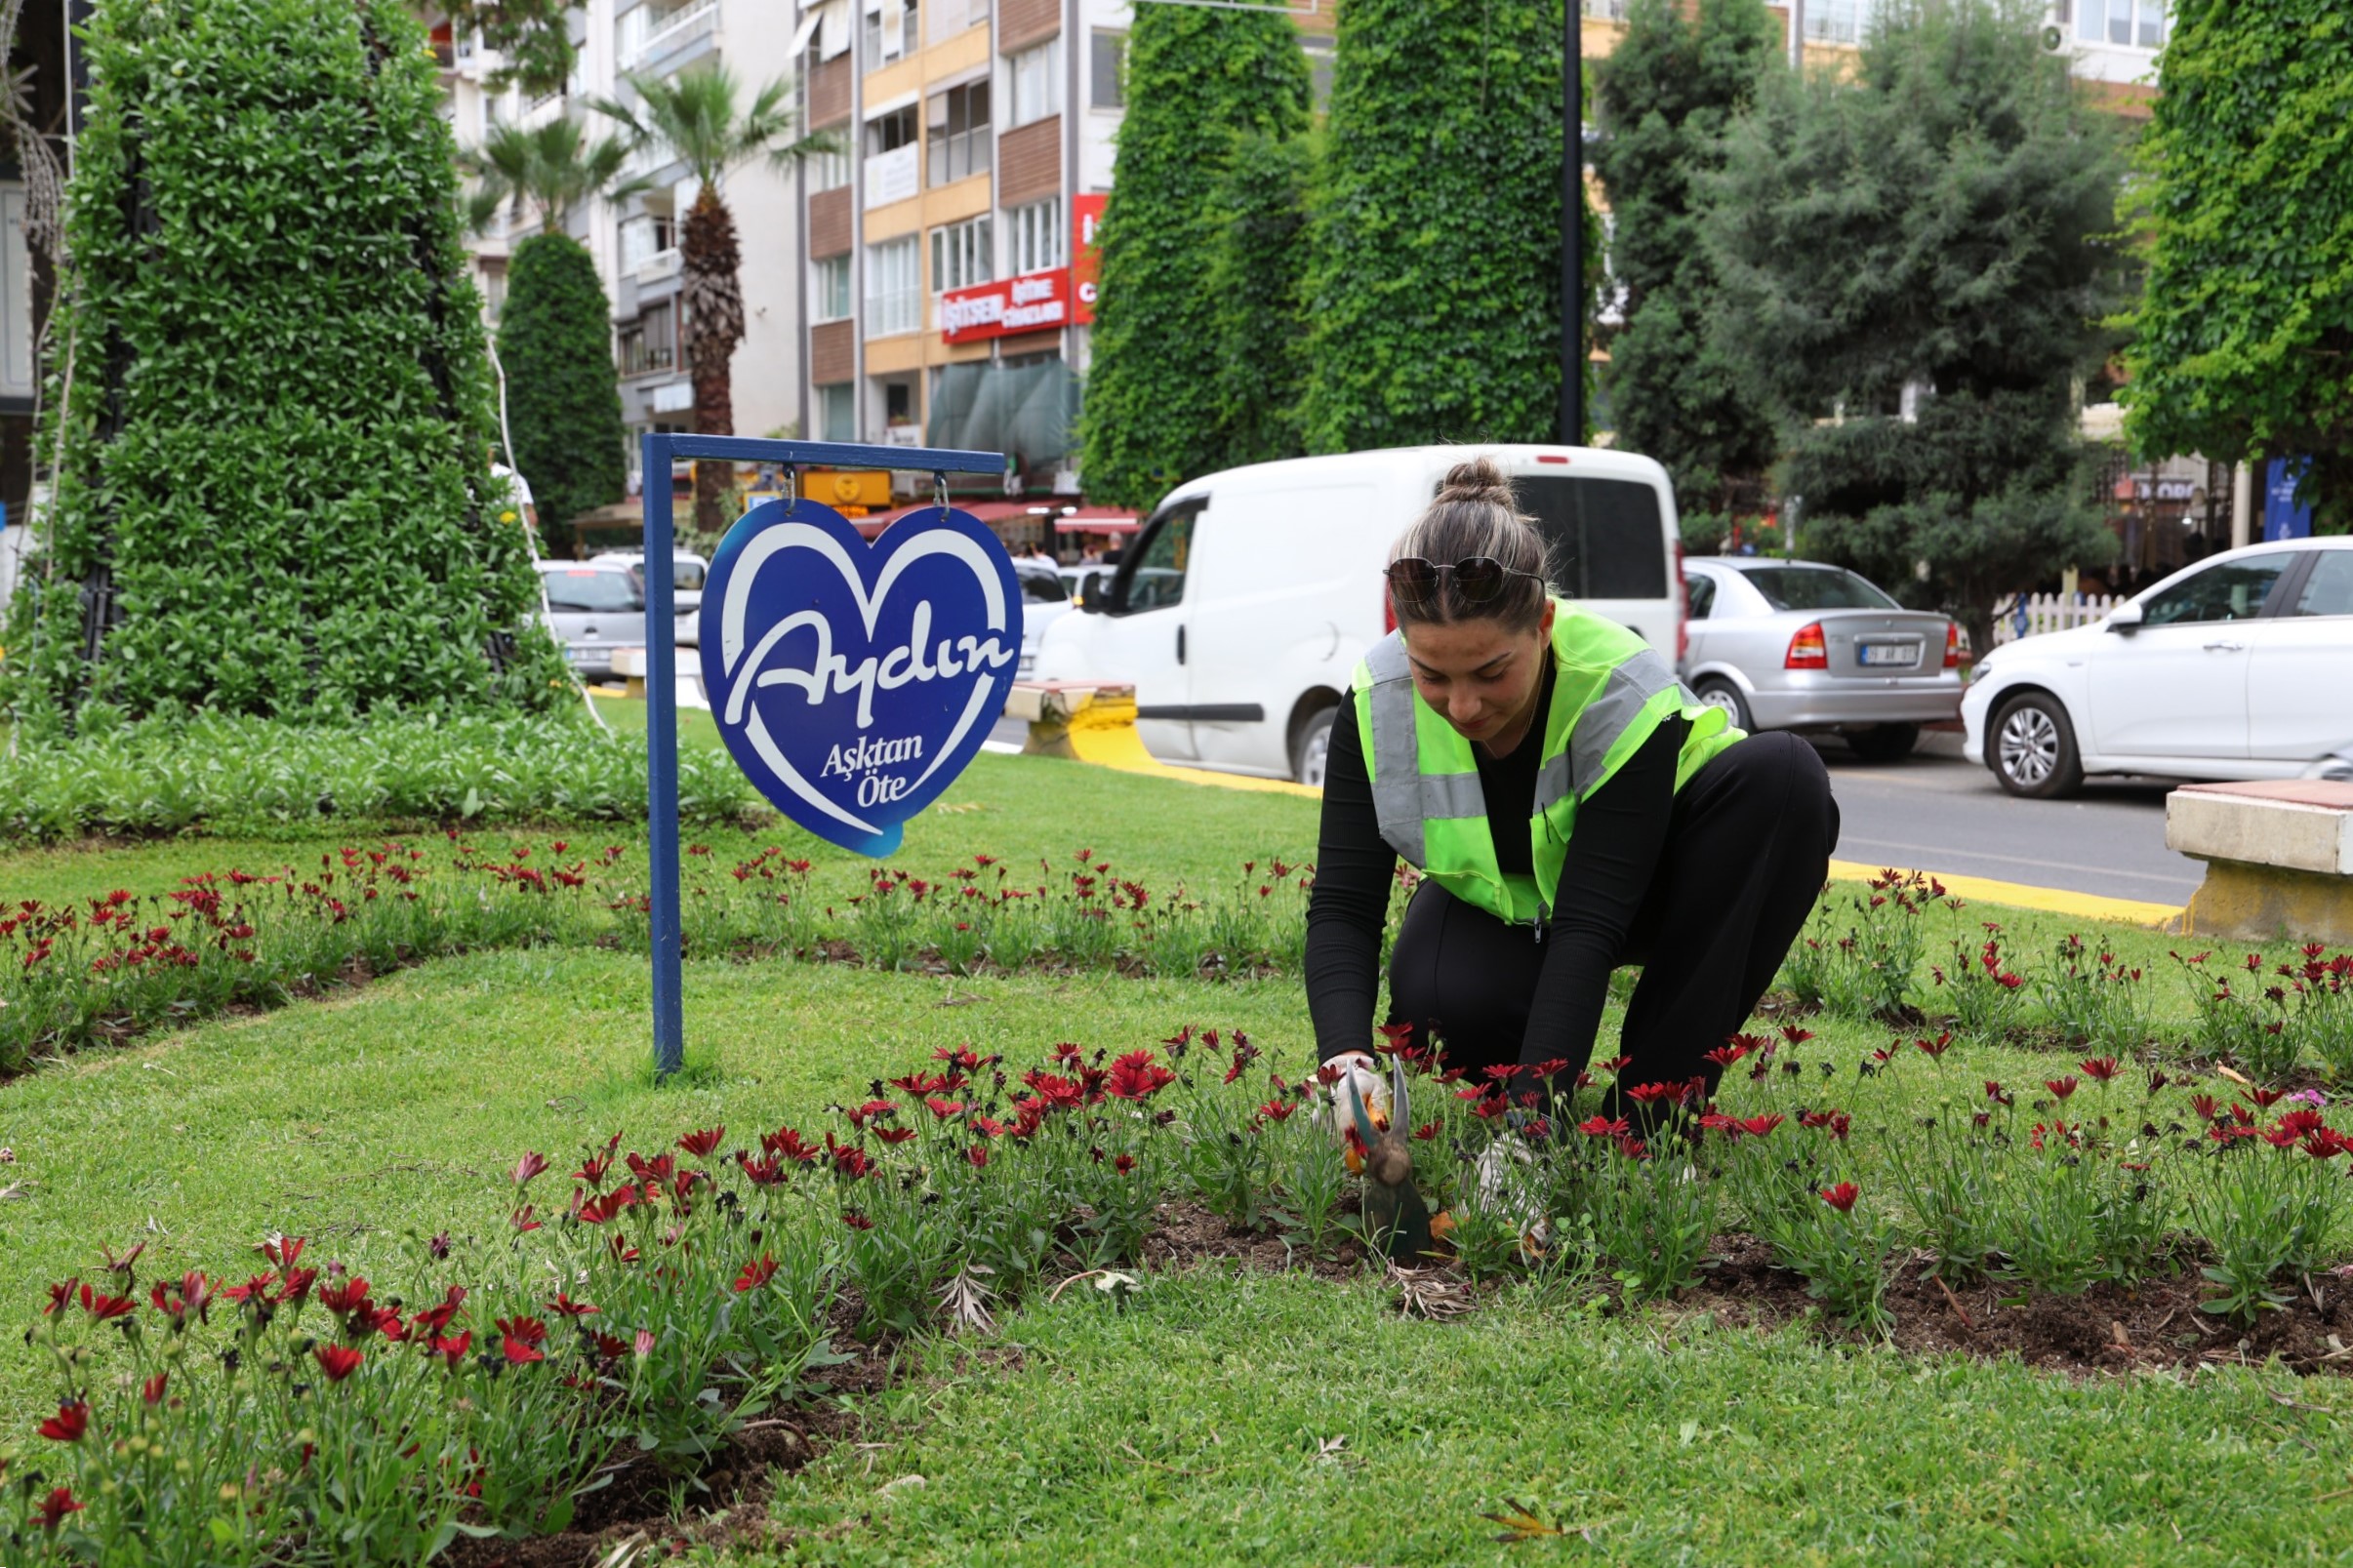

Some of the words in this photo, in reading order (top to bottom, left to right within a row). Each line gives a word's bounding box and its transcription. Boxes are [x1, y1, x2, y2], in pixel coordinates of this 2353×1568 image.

[724, 599, 1014, 729] Aydın
[820, 734, 923, 782] Aşktan
[857, 768, 907, 808] Öte
